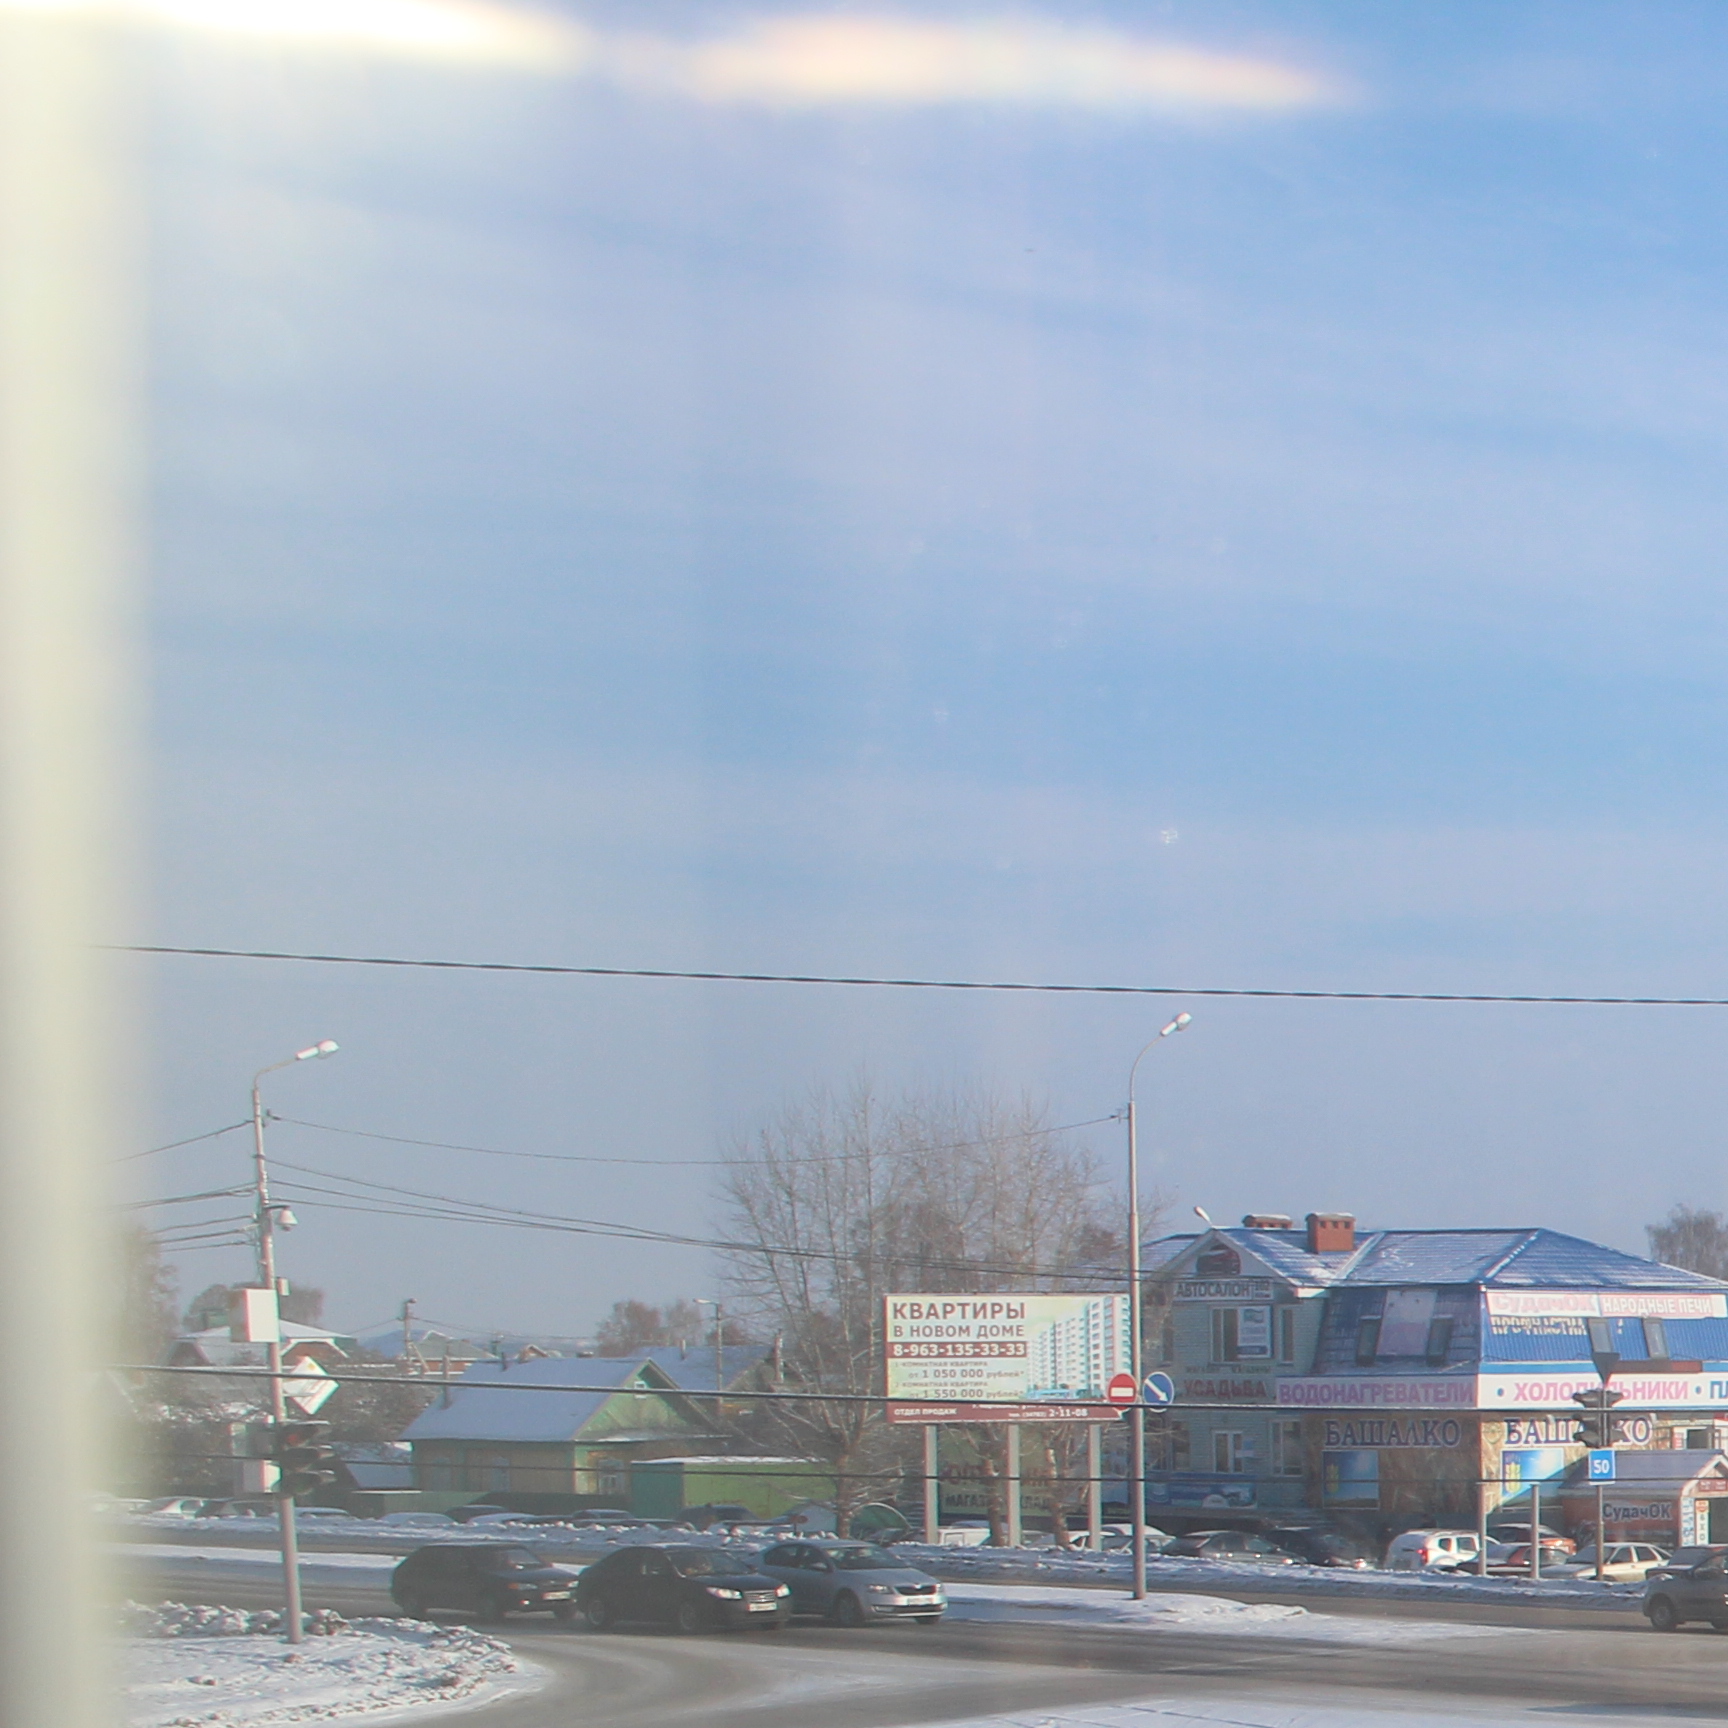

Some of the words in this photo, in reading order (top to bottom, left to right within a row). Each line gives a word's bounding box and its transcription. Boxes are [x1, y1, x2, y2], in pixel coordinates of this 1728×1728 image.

[1175, 1281, 1250, 1298] АВТОСАЛОН
[893, 1302, 1026, 1320] КВАРТИРЫ
[1603, 1298, 1676, 1316] НАРОДНЫЕ
[1679, 1298, 1713, 1314] ПЕЧИ
[893, 1325, 903, 1338] В
[909, 1325, 971, 1338] НОВОМ
[976, 1325, 1025, 1339] ДОМЕ
[893, 1343, 1026, 1357] 8-963-135-33-33
[1279, 1381, 1474, 1405] ВОДОНАГРЕВАТЕЛИ
[894, 1408, 921, 1416] ОТДЕЛ
[1324, 1418, 1462, 1448] БАШАЛКО
[1503, 1416, 1653, 1446] БАШКО
[1593, 1459, 1610, 1474] 50
[1602, 1502, 1673, 1522] СудачОК
